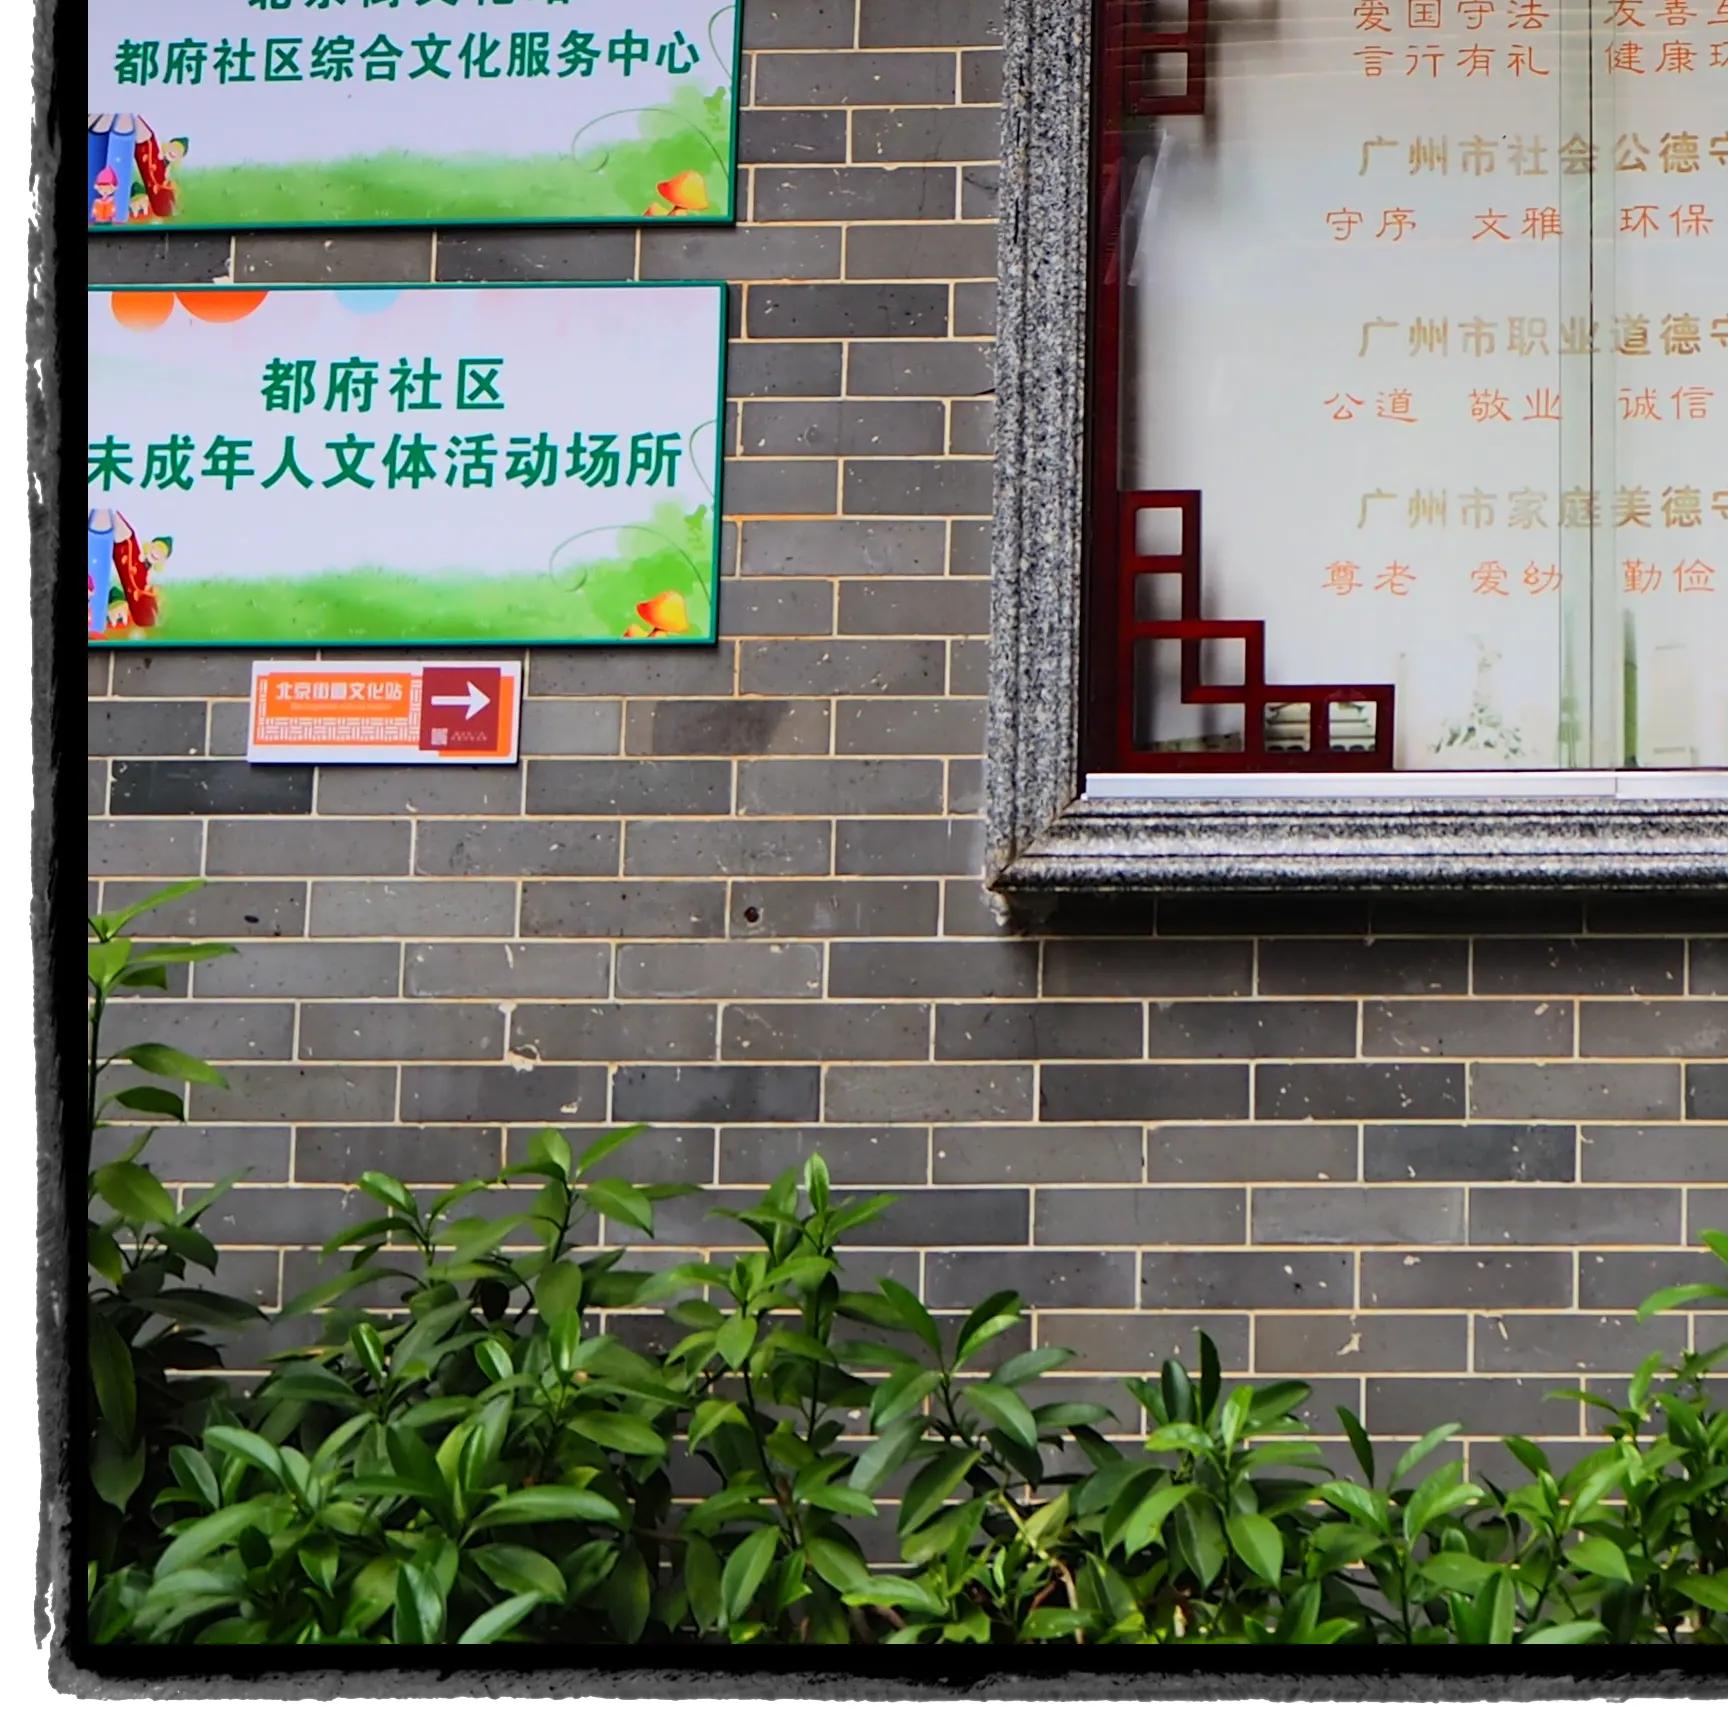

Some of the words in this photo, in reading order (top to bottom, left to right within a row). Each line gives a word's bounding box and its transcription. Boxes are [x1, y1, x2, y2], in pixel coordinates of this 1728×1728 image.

[113, 28, 701, 87] 都府社区综合文化服务中心
[1353, 41, 1552, 79] 言行有礼
[1324, 206, 1418, 244] 守序
[1471, 206, 1566, 243] 文雅
[1619, 203, 1716, 239] 环保
[260, 356, 506, 414] 都府社区
[1323, 389, 1420, 426] 公道
[1467, 387, 1564, 424] 敬业
[1619, 385, 1716, 422] 诚信
[88, 431, 683, 492] 未成年人文体活动场所
[1322, 560, 1418, 599] 尊老
[1469, 559, 1566, 598] 爱幼
[1622, 557, 1717, 594] 勤俭
